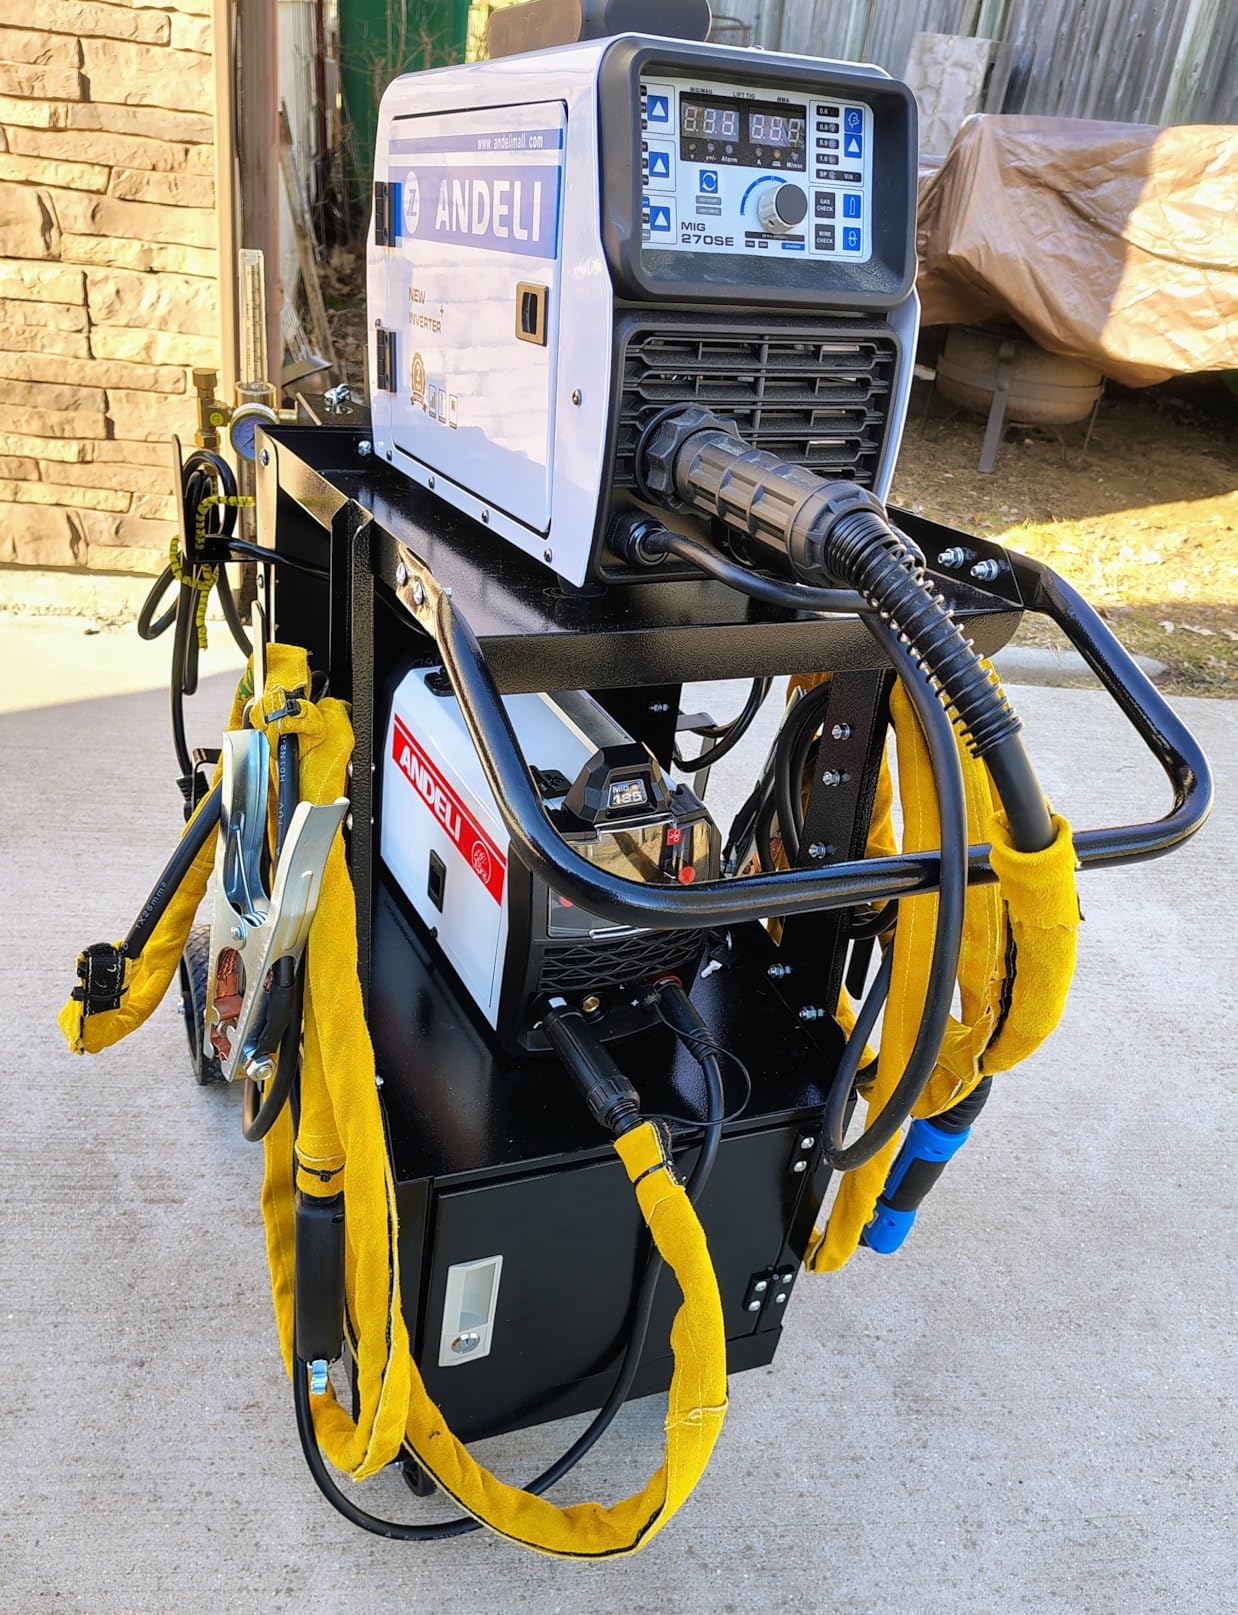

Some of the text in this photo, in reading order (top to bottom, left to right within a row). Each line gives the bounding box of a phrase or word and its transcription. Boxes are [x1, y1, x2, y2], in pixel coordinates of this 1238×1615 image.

[721, 155, 738, 163] Alarm
[435, 179, 542, 242] ANDELI
[681, 222, 706, 231] MIG
[681, 234, 735, 247] 270SE
[409, 287, 426, 304] NEW
[408, 311, 442, 336] INVERTER
[400, 745, 462, 842] ANDELI
